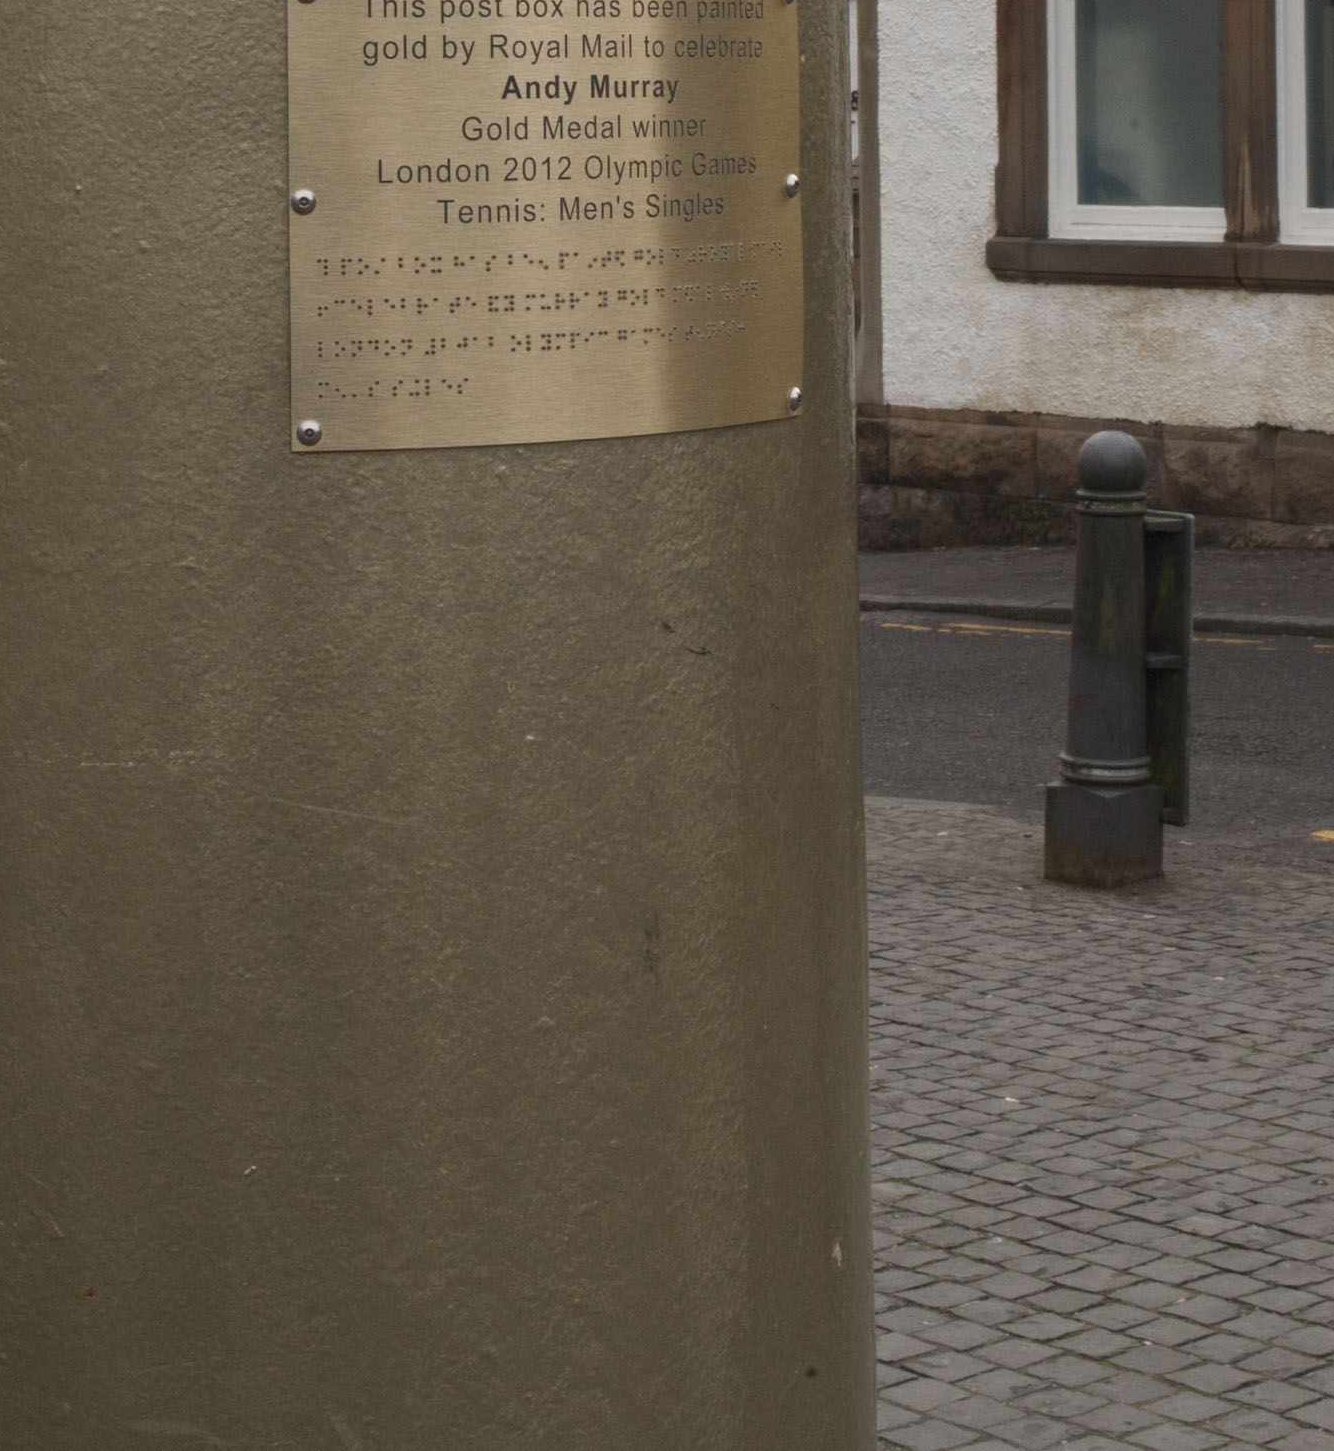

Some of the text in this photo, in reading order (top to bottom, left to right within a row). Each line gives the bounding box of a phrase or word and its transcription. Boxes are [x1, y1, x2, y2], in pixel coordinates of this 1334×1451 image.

[363, 34, 763, 66] gold by Royal Mail to celebrate
[501, 74, 679, 105] Andy Murray
[462, 114, 707, 141] Gold Medal winner
[378, 152, 757, 186] London 2012 Olympic Games
[437, 193, 725, 224] Tennis: Men's Singles
